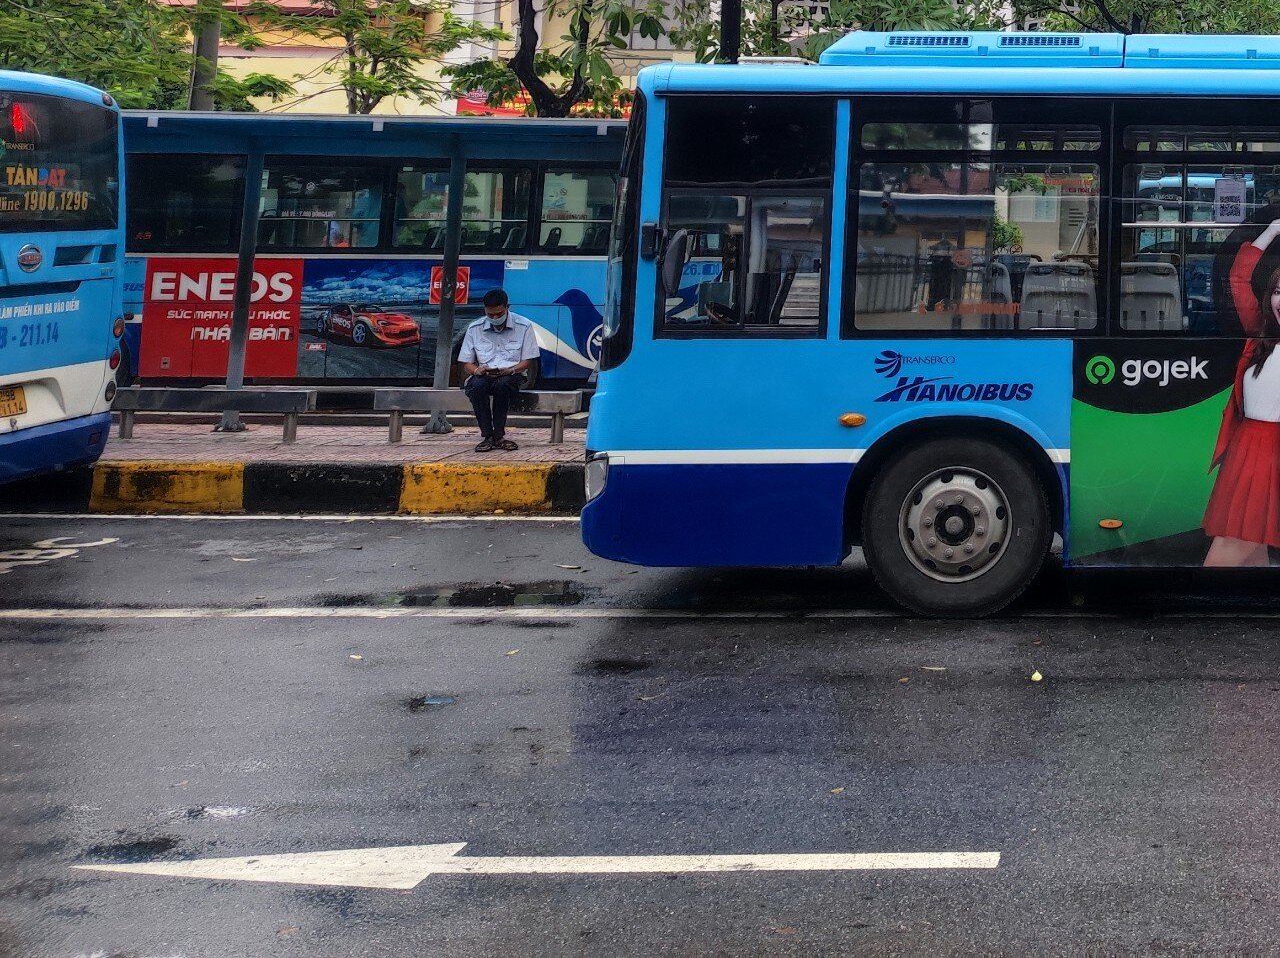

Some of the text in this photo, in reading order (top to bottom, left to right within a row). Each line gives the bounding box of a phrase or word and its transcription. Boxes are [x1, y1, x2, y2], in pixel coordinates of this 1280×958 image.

[23, 190, 89, 211] 1900.1296
[19, 321, 59, 348] 211.14
[190, 324, 231, 343] NHẬ
[899, 354, 956, 365] TRANSERCO
[1121, 356, 1210, 387] gojek
[873, 376, 1034, 402] HANOIBUS
